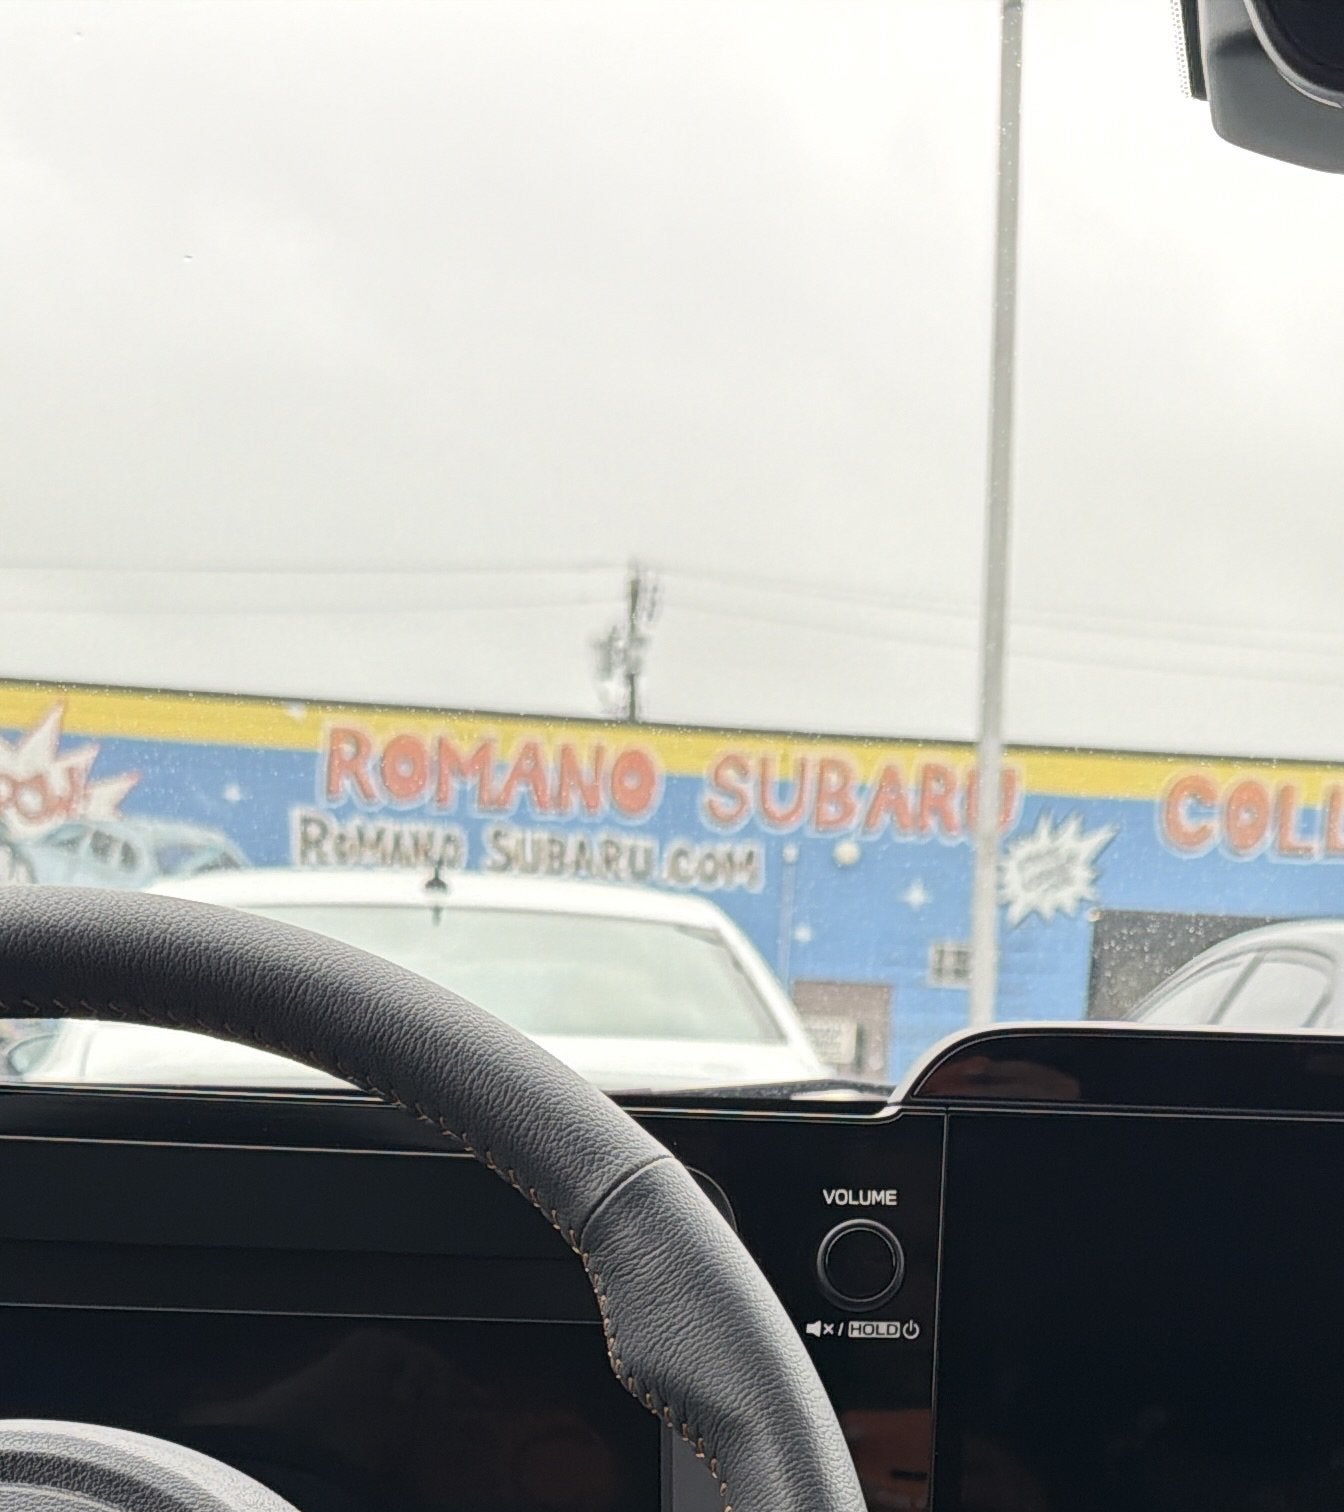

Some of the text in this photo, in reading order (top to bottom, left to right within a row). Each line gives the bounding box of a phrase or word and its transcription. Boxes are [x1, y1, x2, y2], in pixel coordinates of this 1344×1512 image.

[324, 725, 659, 815] ROMANO
[707, 752, 1018, 836] SUBARU
[822, 1188, 898, 1206] VOLUME
[849, 1323, 899, 1337] HOLD
